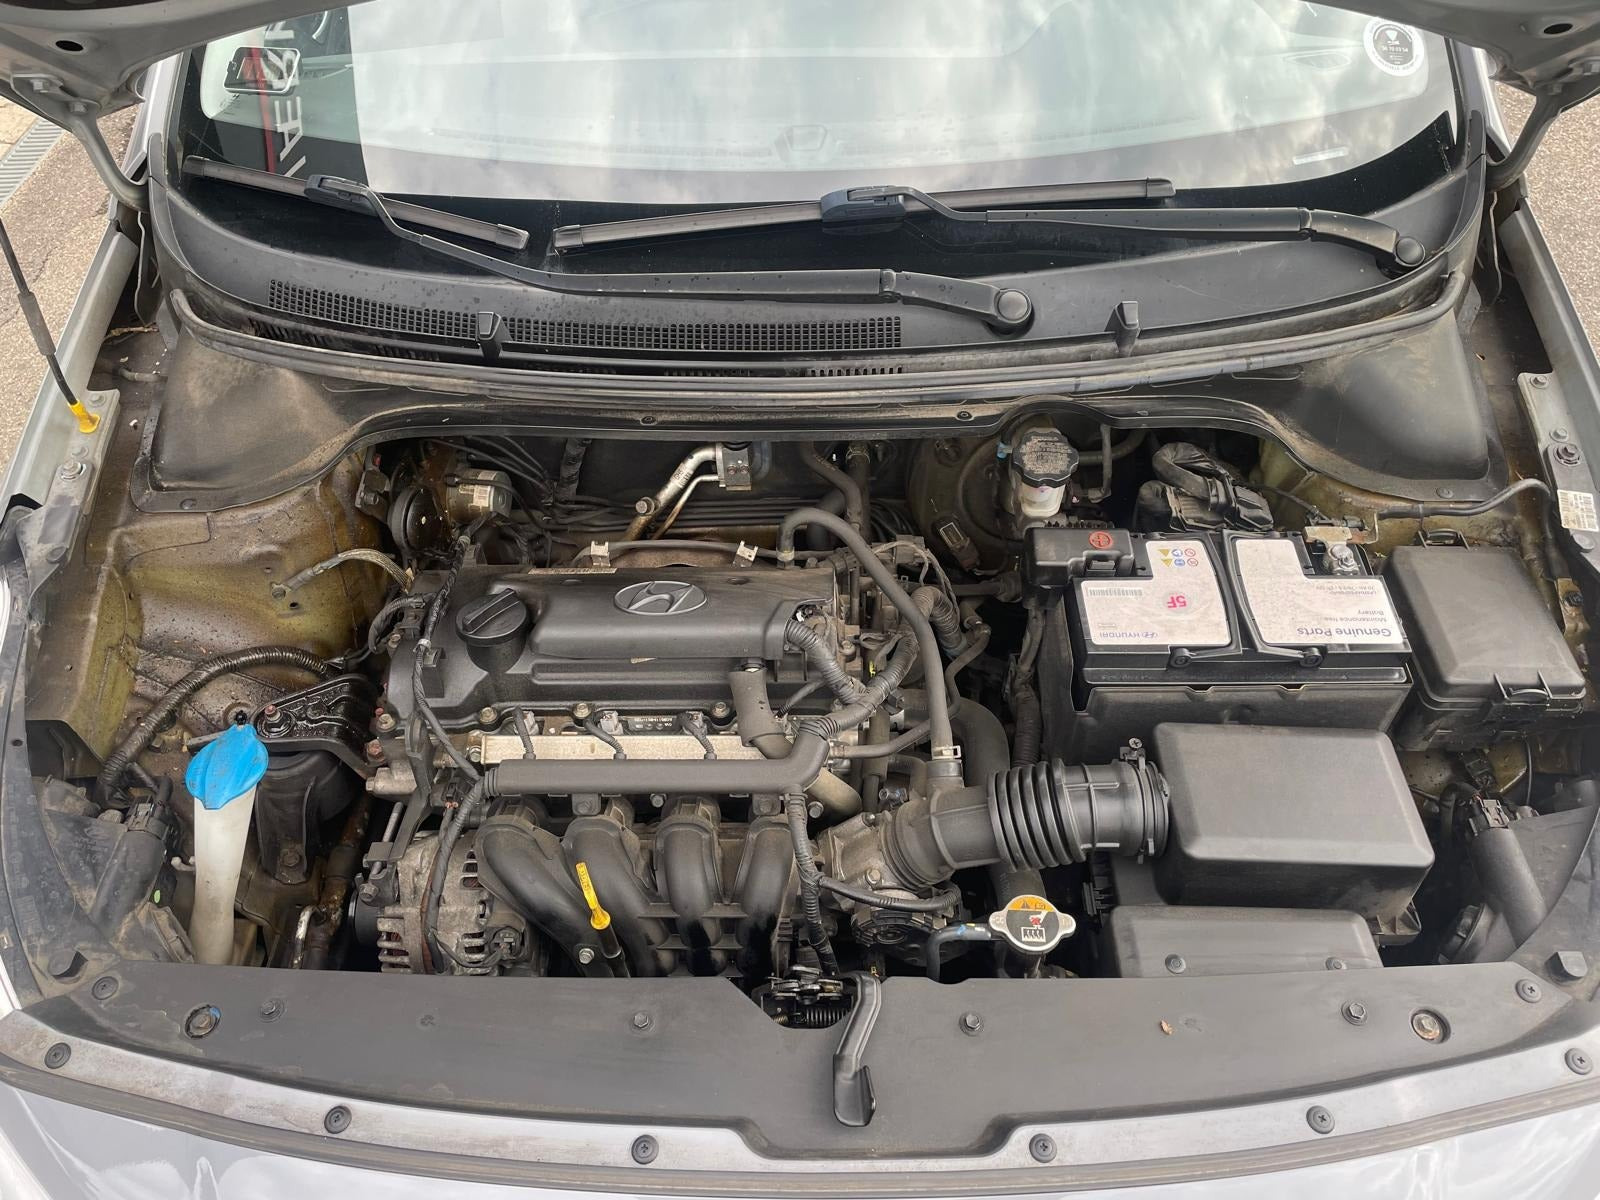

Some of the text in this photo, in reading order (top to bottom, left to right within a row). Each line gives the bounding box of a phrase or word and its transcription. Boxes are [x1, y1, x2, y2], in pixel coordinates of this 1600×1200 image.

[1166, 595, 1187, 609] 5F
[1100, 631, 1140, 639] HYUNDAI
[1297, 627, 1392, 637] Genuine Parts
